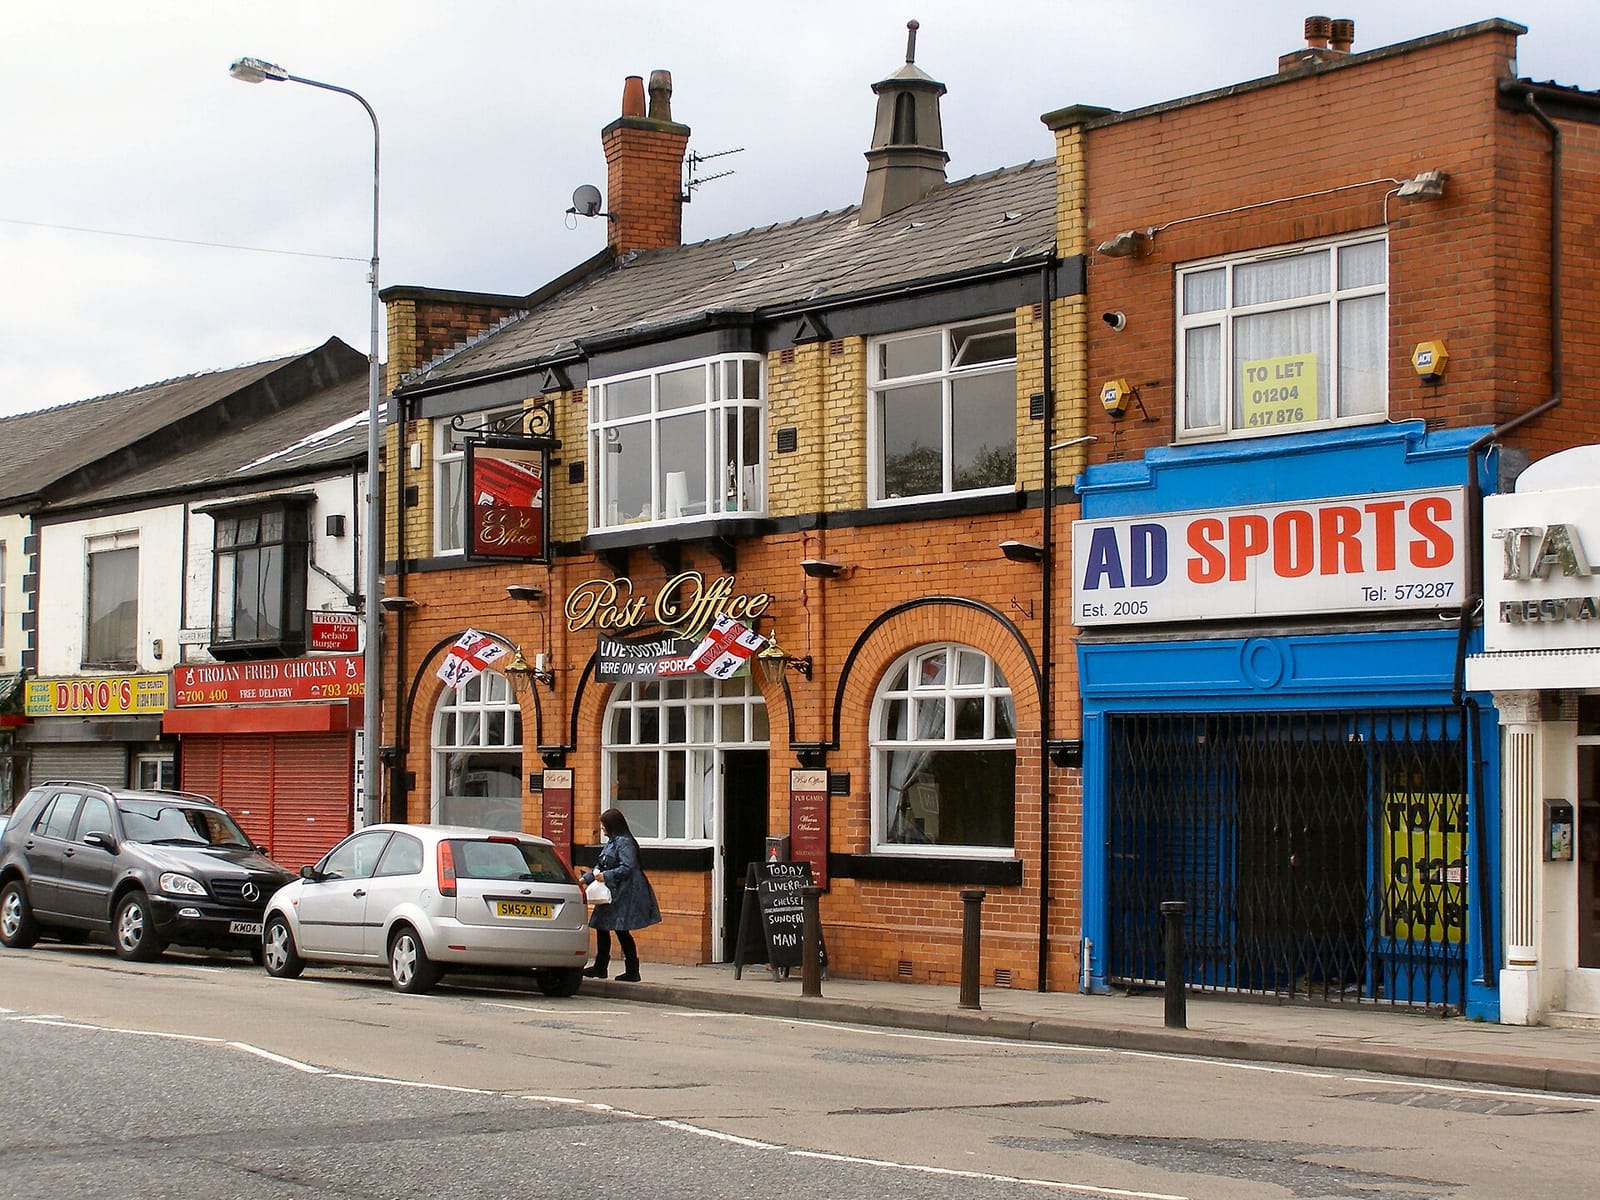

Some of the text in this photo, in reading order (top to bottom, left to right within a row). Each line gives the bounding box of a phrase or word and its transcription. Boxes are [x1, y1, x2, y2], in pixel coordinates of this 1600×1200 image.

[1247, 362, 1304, 383] TO LET
[1252, 386, 1299, 404] 01204
[1249, 407, 1304, 426] 417 876
[480, 525, 537, 546] Office
[1083, 496, 1455, 590] AD SPORTS
[1491, 524, 1600, 580] TA
[1361, 582, 1455, 602] Tel: 573287
[564, 571, 769, 641] Post Office
[1083, 601, 1148, 617] Est. 2005
[1499, 597, 1600, 623] RESTA
[315, 615, 355, 624] TROJAN
[333, 624, 356, 632] Pizza
[312, 640, 341, 649] Burger
[321, 632, 348, 640] Kebab
[600, 637, 677, 658] LIVE FOOTBALL
[198, 661, 337, 683] TROJAN FRIED CHICKEN
[600, 662, 619, 675] HERE
[622, 663, 635, 675] ON
[637, 661, 657, 674] SKY
[56, 680, 132, 711] DINO'S
[186, 689, 228, 702] 700 400
[240, 687, 293, 698] FREE DELIVERY
[321, 684, 341, 696] 793
[501, 903, 549, 916] SM52 XRJ
[773, 933, 797, 947] MAN
